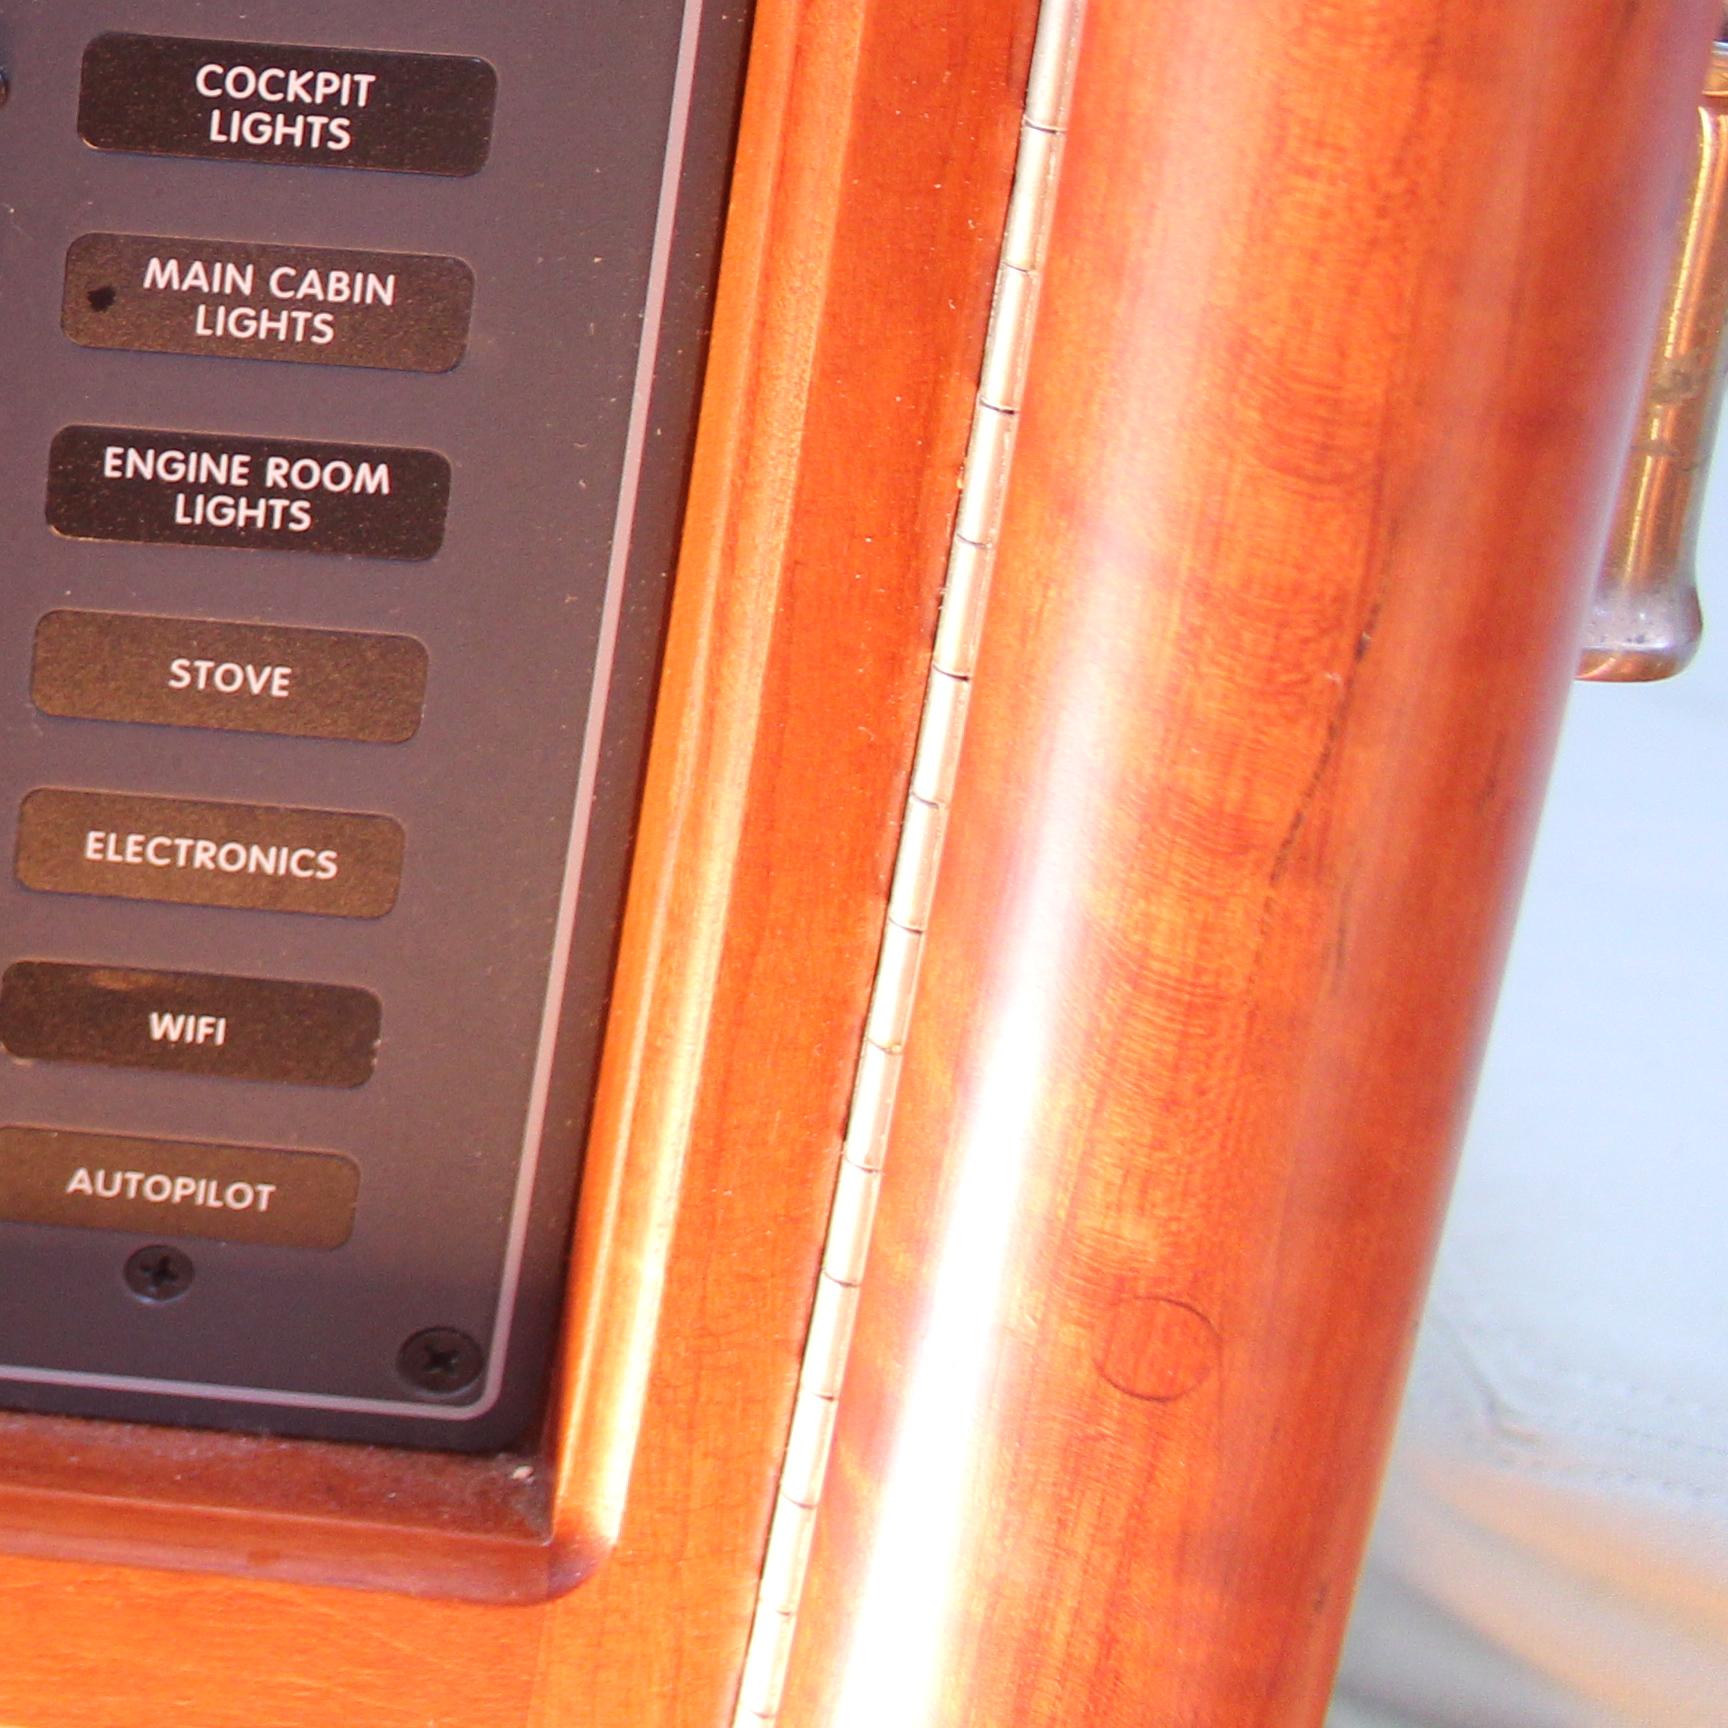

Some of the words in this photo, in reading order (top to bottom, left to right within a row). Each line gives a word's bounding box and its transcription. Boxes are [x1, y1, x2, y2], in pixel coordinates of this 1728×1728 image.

[196, 63, 376, 108] COCKPIT
[209, 109, 351, 150] LIGHTS
[143, 257, 254, 296] MAIN
[269, 266, 395, 306] CABIN
[195, 304, 334, 344] LIGHTS
[103, 446, 251, 486] ENGINE
[265, 456, 390, 495] ROOM
[175, 493, 311, 531] LIGHTS
[168, 658, 292, 697] STOVE
[85, 830, 338, 880] ELECTRONICS
[149, 1012, 226, 1046] WIFI
[66, 1167, 276, 1212] AUTOPILOT
